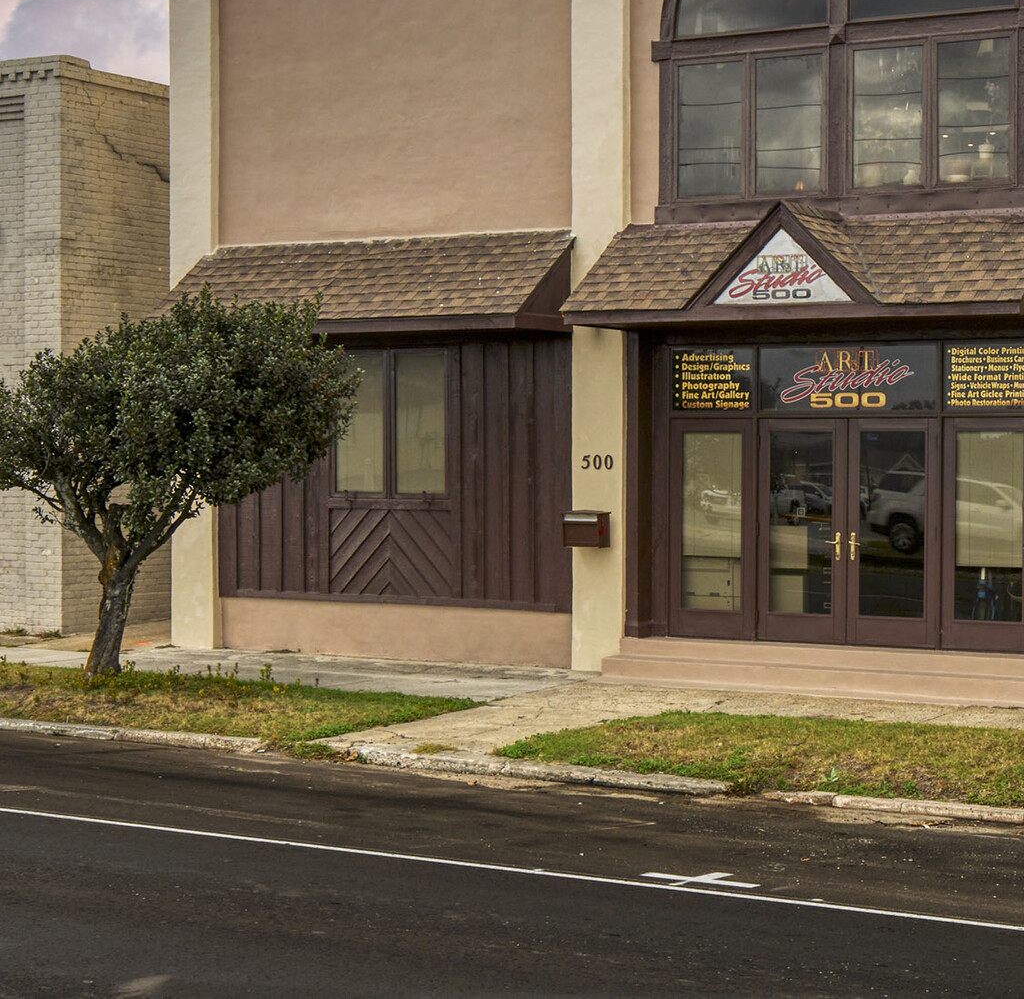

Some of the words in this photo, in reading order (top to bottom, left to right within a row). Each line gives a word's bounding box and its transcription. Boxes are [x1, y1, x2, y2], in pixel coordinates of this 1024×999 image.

[758, 254, 806, 274] ART
[729, 264, 826, 298] Studio
[752, 289, 811, 300] 500
[951, 347, 977, 357] Digital
[978, 347, 1000, 355] Color
[682, 353, 734, 363] Advertising
[817, 350, 877, 372] ART
[986, 355, 1013, 363] Business
[681, 362, 751, 372] Design/Graphics
[951, 364, 984, 373] Stationery
[682, 372, 731, 380] Illustration
[781, 359, 914, 403] Studio
[951, 373, 972, 381] Wide
[974, 373, 1001, 381] Format
[682, 381, 740, 391] Photography
[951, 382, 966, 390] Signs
[682, 391, 699, 399] Fine
[701, 391, 750, 400] Art/Gallery
[951, 390, 966, 398] Fine
[967, 390, 980, 398] Art
[980, 390, 1003, 398] Giclee
[715, 400, 750, 410] Signage
[810, 392, 886, 408] 500
[581, 455, 614, 470] 500
